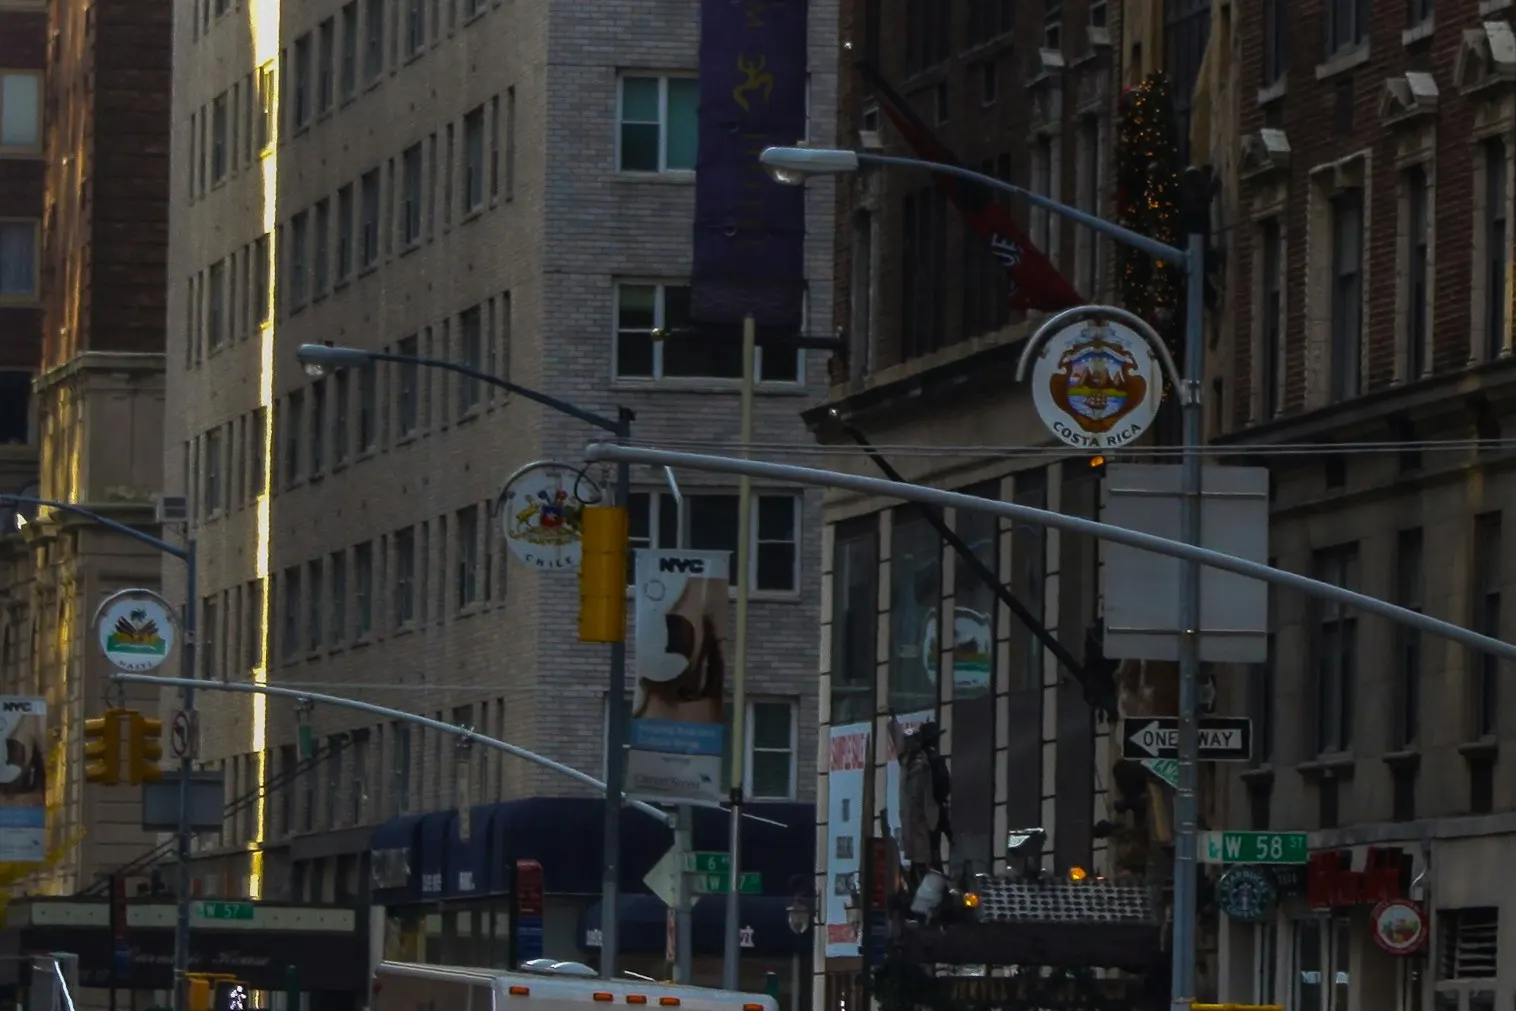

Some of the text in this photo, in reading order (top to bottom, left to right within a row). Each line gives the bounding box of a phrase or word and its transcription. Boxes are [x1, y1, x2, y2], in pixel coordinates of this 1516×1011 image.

[1053, 421, 1143, 448] COSTA RICA
[525, 553, 573, 569] CHILE
[660, 557, 703, 572] NYC
[3, 700, 33, 712] NYC
[1143, 730, 1178, 747] ONE
[1224, 835, 1305, 860] W 58 ST
[707, 856, 717, 870] 6
[708, 877, 721, 890] W
[204, 905, 241, 918] W 57
